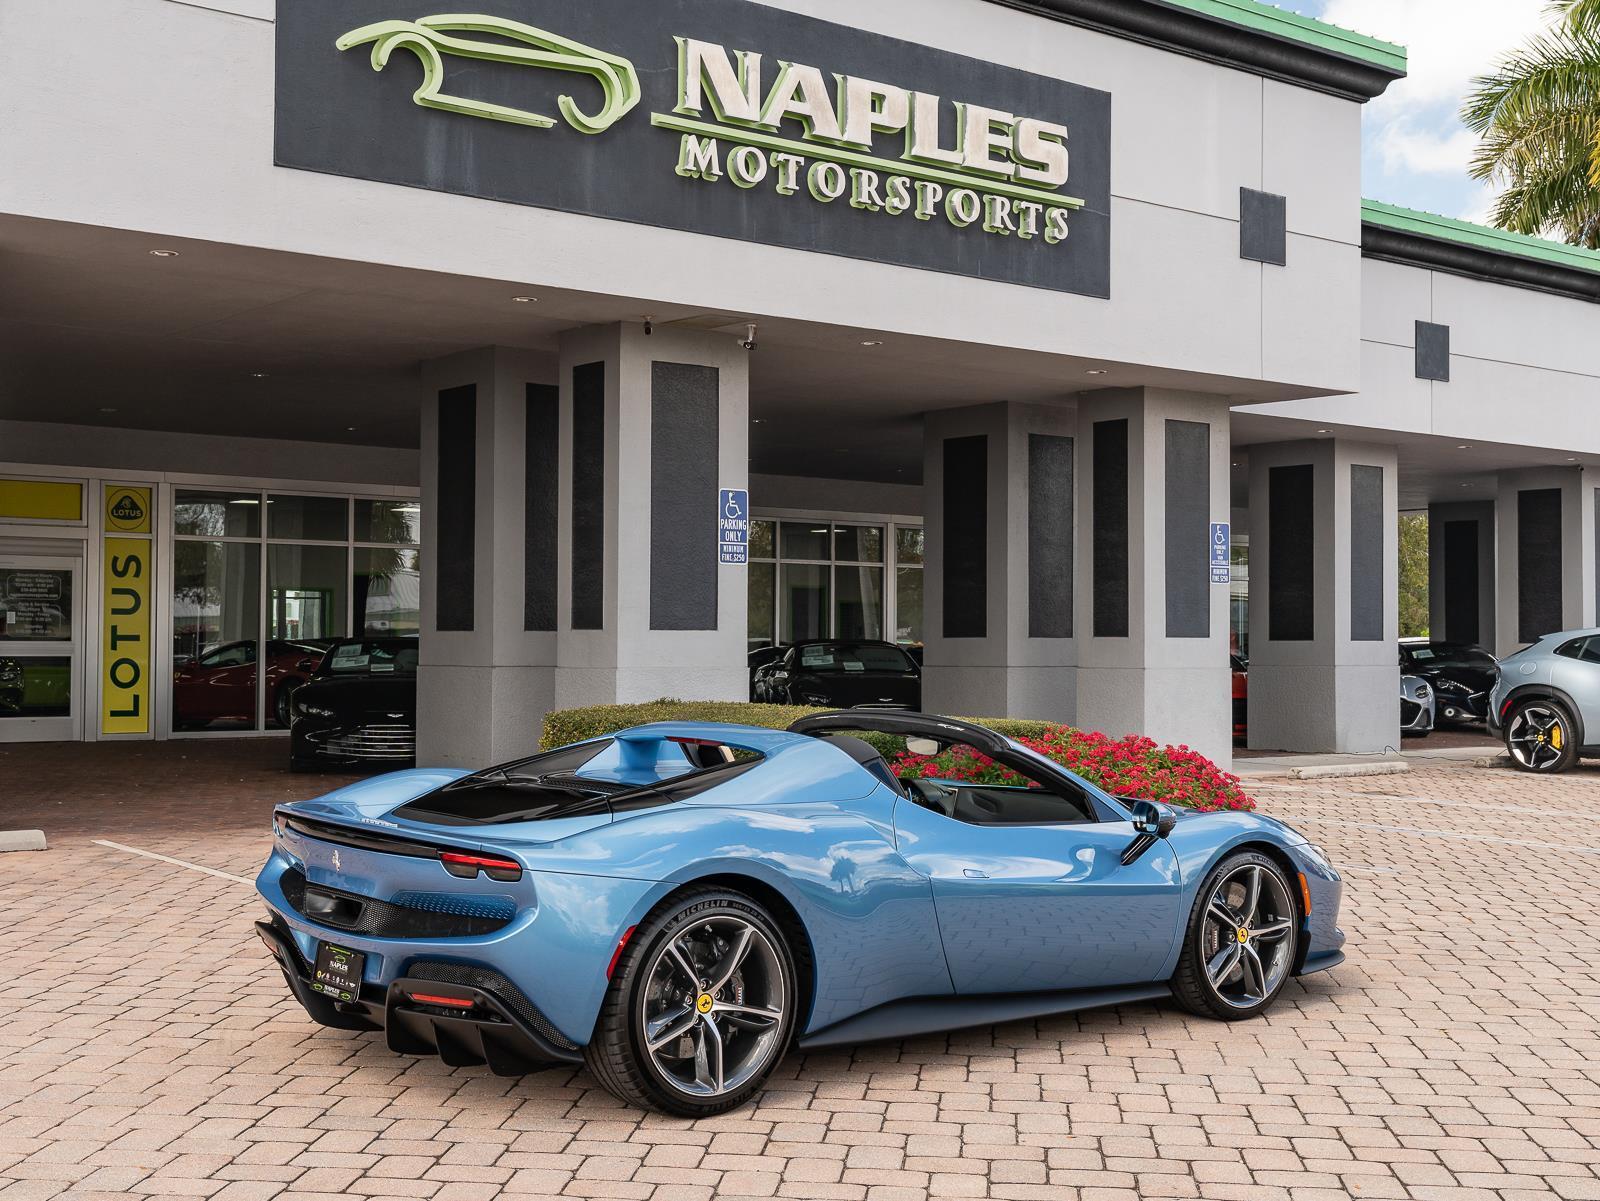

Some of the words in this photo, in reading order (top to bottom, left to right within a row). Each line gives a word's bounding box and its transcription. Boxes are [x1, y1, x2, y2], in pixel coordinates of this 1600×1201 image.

[673, 36, 1069, 188] NAPLES
[675, 133, 1069, 244] MOTORSPORTS
[113, 509, 142, 518] LOTUS
[720, 519, 747, 530] PARKING
[725, 531, 742, 542] ONLY
[723, 545, 744, 553] MINIMUM
[110, 554, 142, 717] LOTUS
[678, 900, 729, 921] MICHELIN
[330, 961, 348, 971] NAPLES
